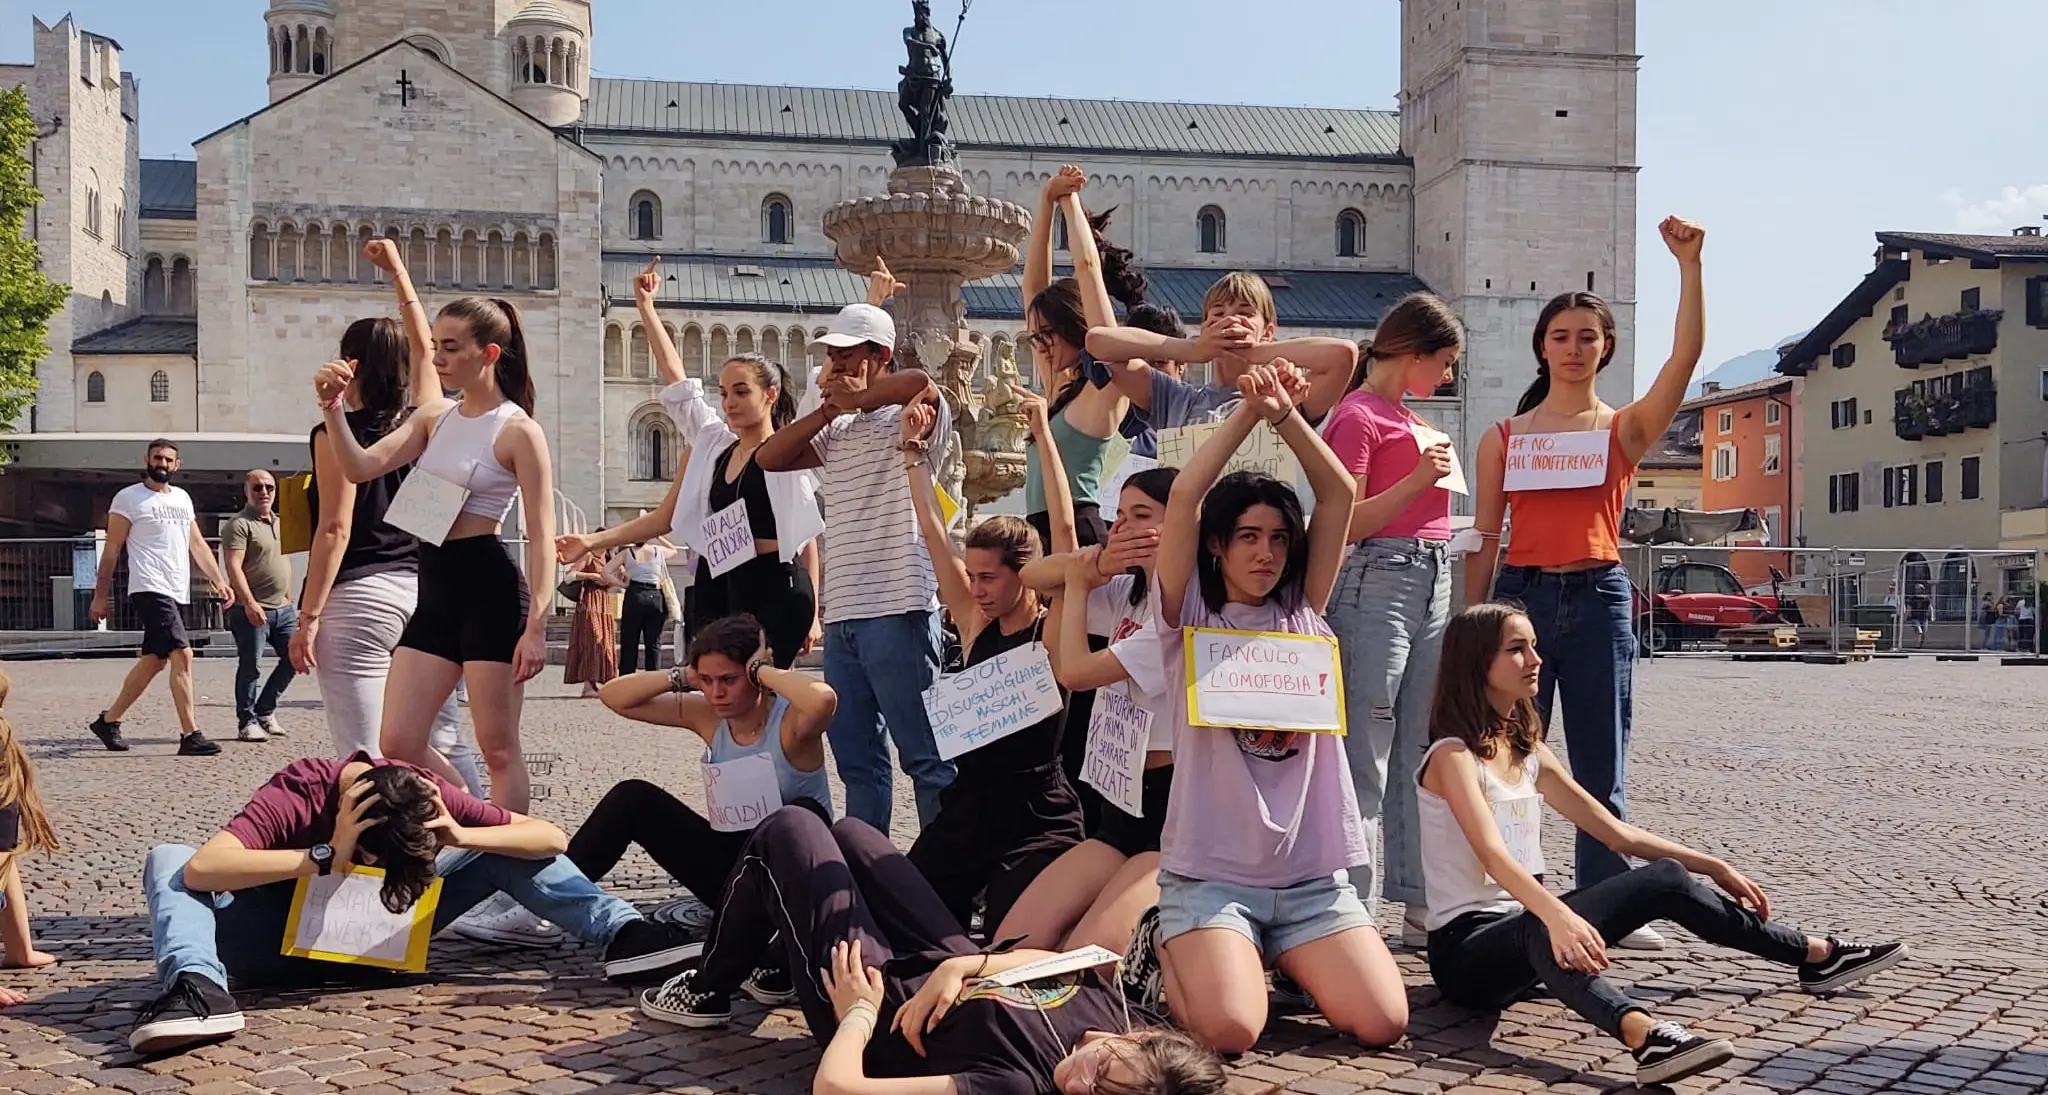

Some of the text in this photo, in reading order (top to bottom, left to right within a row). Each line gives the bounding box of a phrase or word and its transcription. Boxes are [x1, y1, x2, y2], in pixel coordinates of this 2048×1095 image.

[1532, 437, 1556, 451] NO
[702, 504, 747, 541] NO ALLA
[707, 526, 752, 567] CENSURA
[1209, 641, 1299, 665] FANCULO
[953, 655, 1008, 690] STOP
[935, 678, 1052, 739] TRA MASCHI E
[960, 701, 1040, 744] FEMMINE
[1105, 691, 1148, 733] INFORMATI
[1104, 716, 1139, 751] PRIMA DI
[1099, 738, 1130, 771] SPARARE
[1087, 751, 1133, 807] CAZZATE
